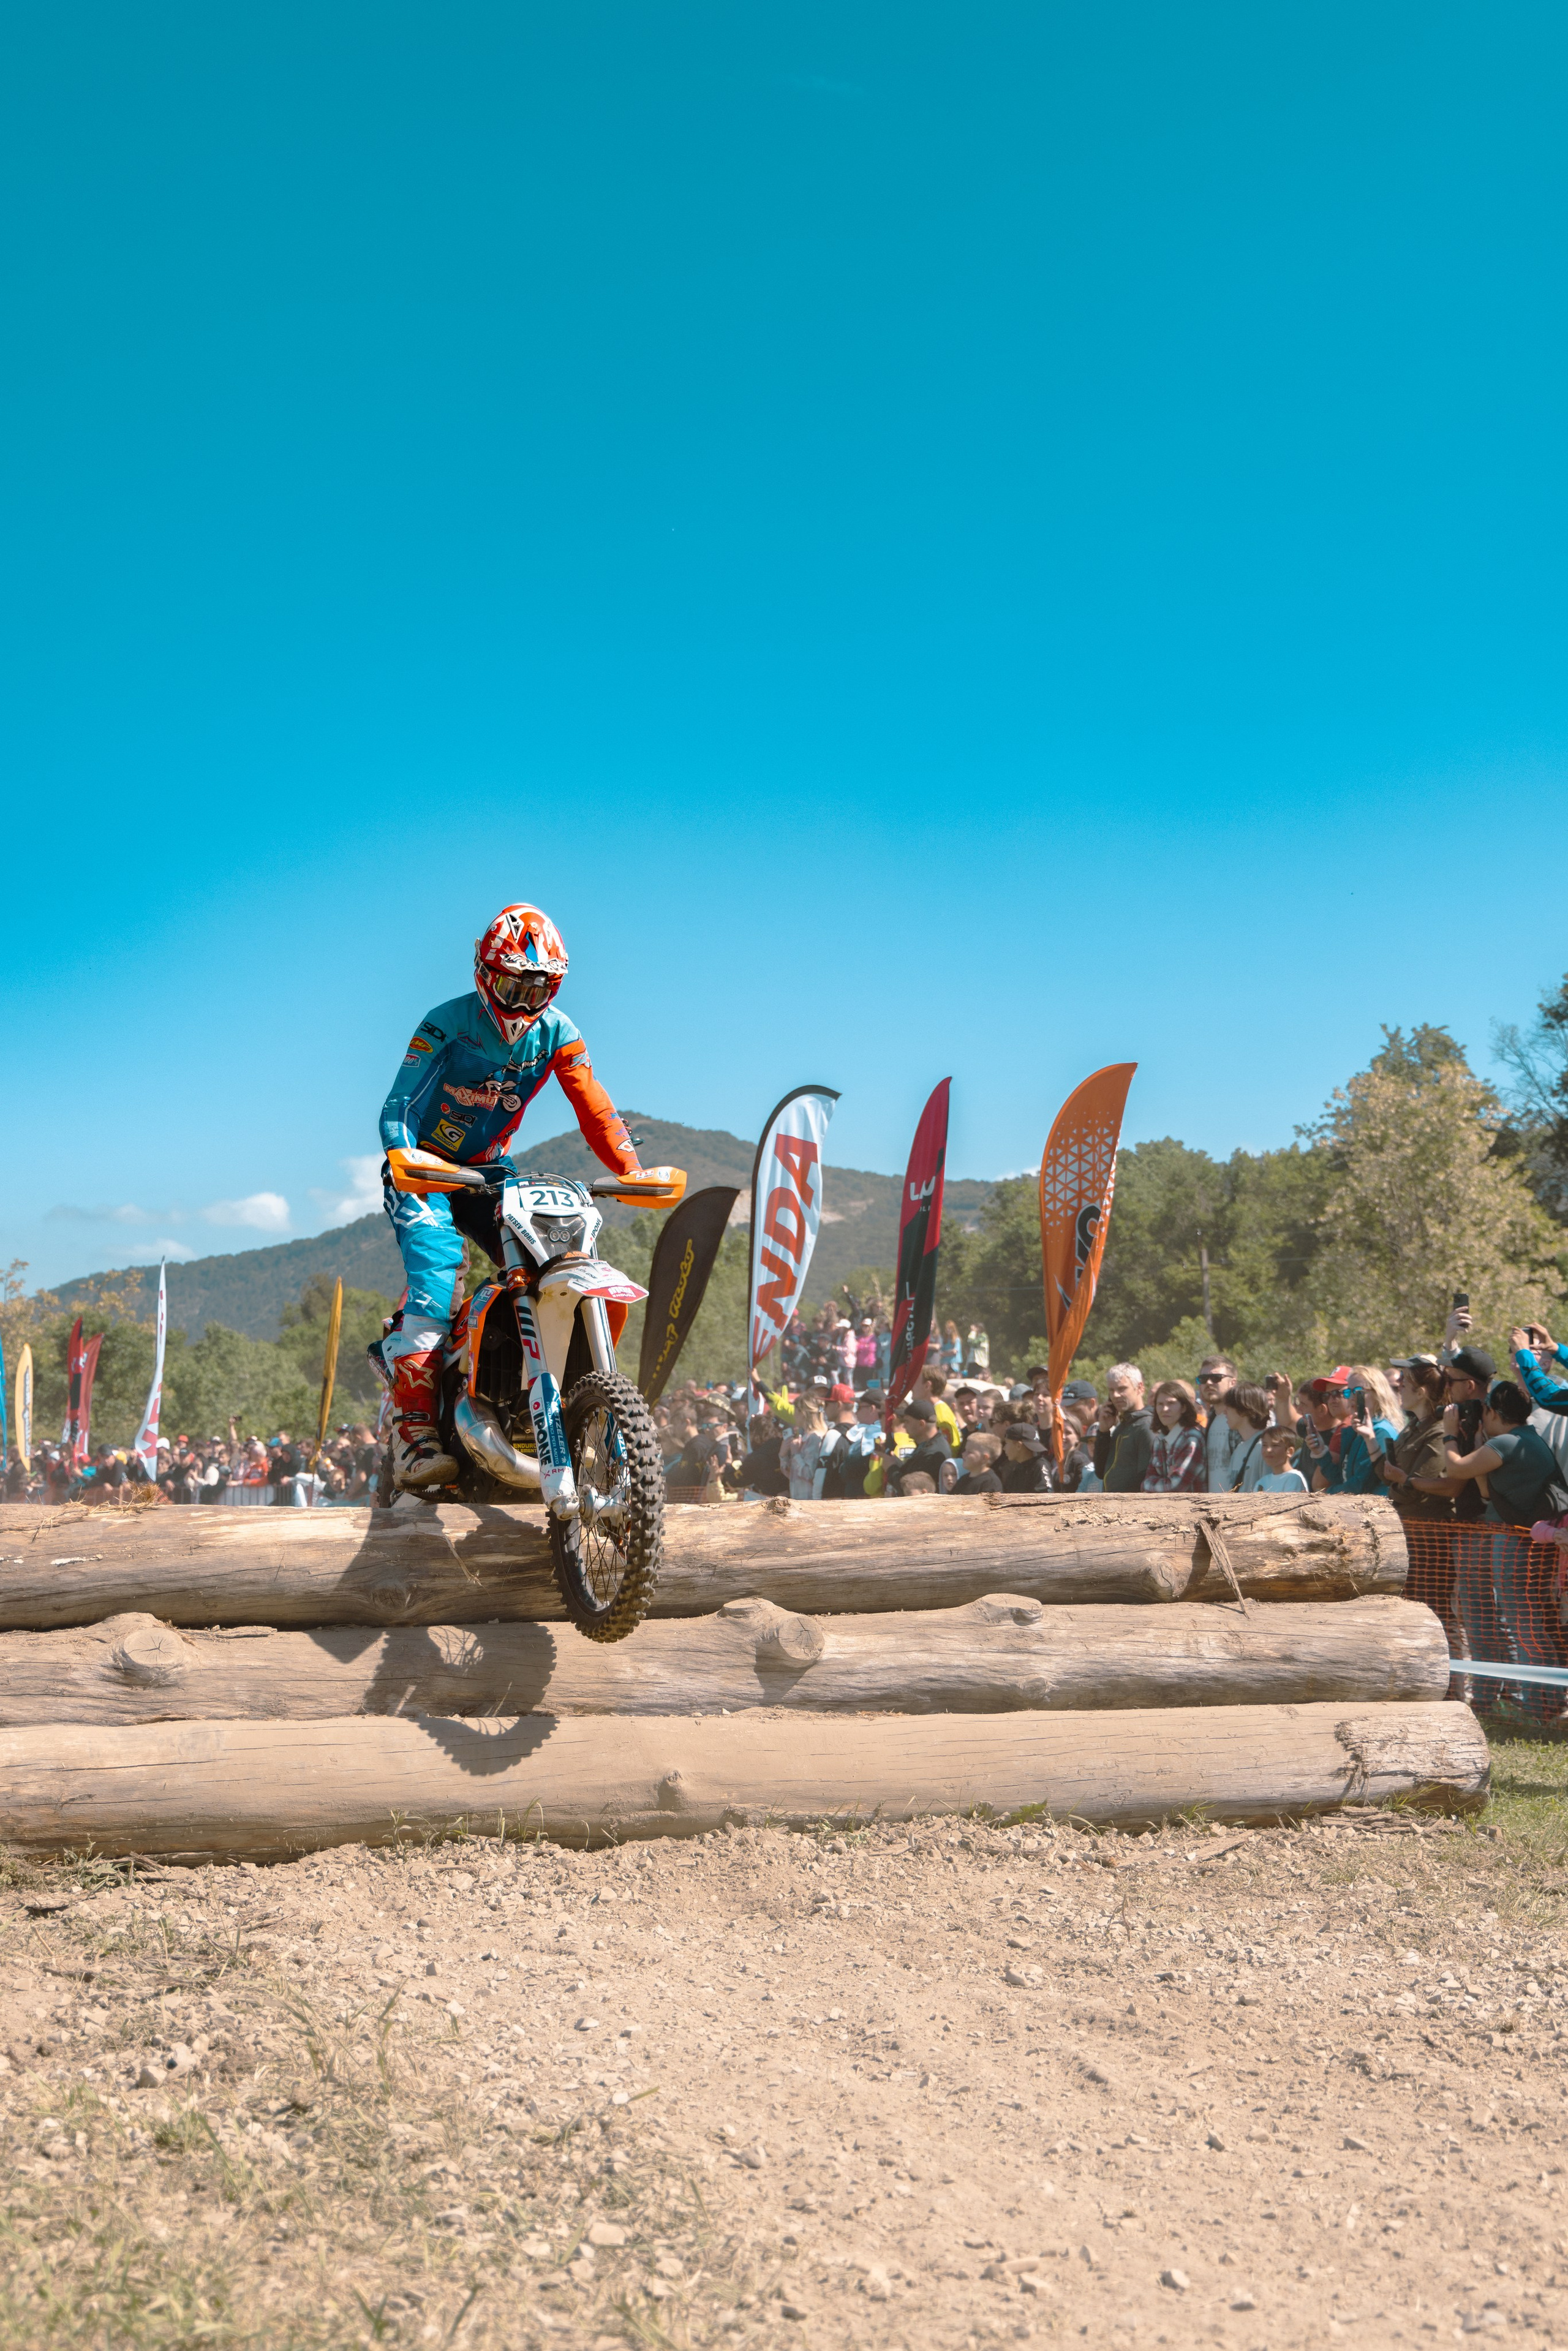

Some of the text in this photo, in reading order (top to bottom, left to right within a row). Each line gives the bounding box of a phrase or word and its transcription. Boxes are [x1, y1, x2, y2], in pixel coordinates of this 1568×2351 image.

[530, 1190, 574, 1207] 213
[506, 1213, 536, 1245] PATSEV BORIS
[592, 1217, 602, 1238] IPONE
[546, 1402, 555, 1436] PNEUMATICI
[533, 1411, 552, 1467] IPONE
